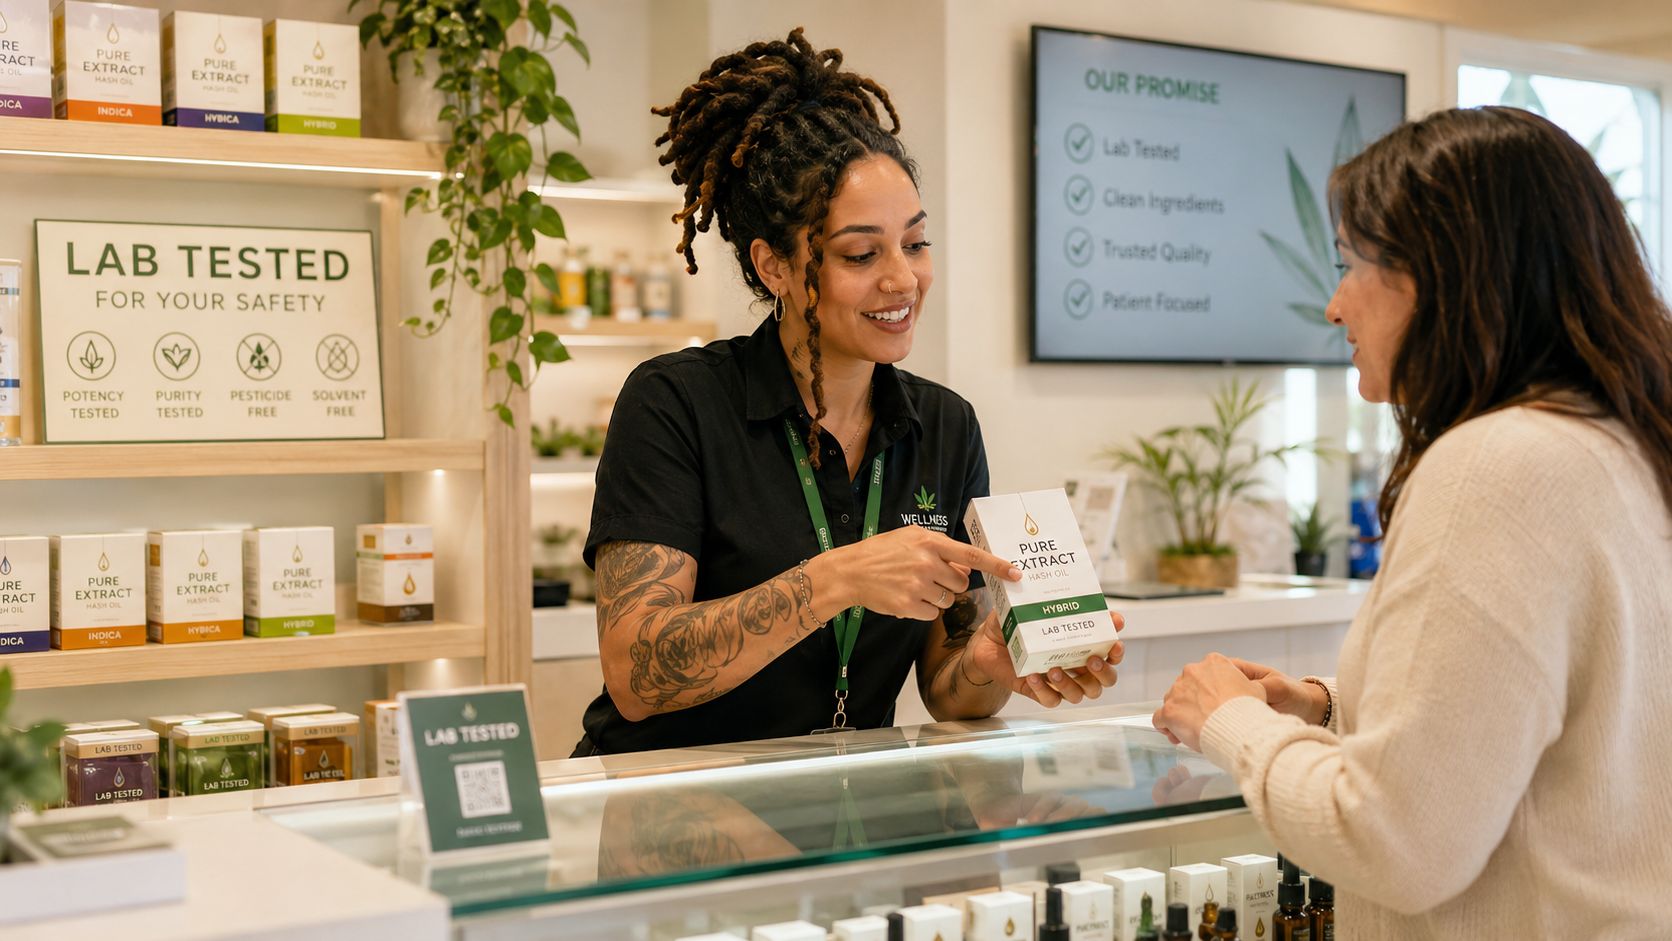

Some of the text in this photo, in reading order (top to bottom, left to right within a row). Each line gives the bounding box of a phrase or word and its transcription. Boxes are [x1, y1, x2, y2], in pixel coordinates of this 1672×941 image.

[2, 40, 20, 51] RE
[0, 54, 36, 66] RACT
[97, 49, 131, 61] PURE
[83, 61, 145, 75] EXTRACT
[204, 58, 237, 70] PURE
[304, 65, 334, 76] PURE
[95, 76, 118, 85] HASH
[192, 70, 250, 85] EXTRACT
[292, 76, 347, 90] EXTRACT
[1085, 68, 1220, 104] OUR PROMISE
[98, 107, 133, 117] INDICA
[304, 120, 337, 130] HYBRID
[1102, 138, 1180, 161] Lab Tested
[1104, 188, 1225, 215] Clean Ingredients
[1102, 240, 1212, 265] Trusted Quality
[67, 242, 349, 281] LAB TESTED
[95, 290, 326, 312] FOR YOUR SAFETY
[1103, 292, 1211, 313] Patient Focused
[63, 390, 124, 402] POTENCY
[156, 390, 202, 401] PURITY
[230, 390, 292, 401] PESTICIDE
[312, 390, 367, 401] SOLVENT
[71, 408, 119, 419] TESTED
[156, 407, 204, 418] TESTED
[248, 406, 278, 418] FREE
[326, 405, 356, 417] FREE
[1019, 540, 1058, 555] PURE
[189, 572, 218, 582] PURE
[284, 568, 312, 578] PURE
[1029, 569, 1069, 581] HASH OIL
[0, 580, 22, 591] URE
[88, 576, 119, 587] PURE
[273, 579, 323, 591] EXTRACT
[76, 588, 132, 600] EXTRACT
[177, 584, 230, 596] EXTRACT
[2, 592, 36, 603] RACT
[1043, 601, 1080, 614] HYBRID
[284, 620, 315, 629] HYBRID
[1042, 620, 1095, 636] LAB TESTED
[0, 637, 24, 646] DICA
[88, 631, 122, 640] INDICA
[222, 734, 250, 742] TESTED
[424, 722, 520, 746] LAB TESTED
[95, 743, 142, 754] LAB TESTED
[204, 779, 250, 790] LAB TESTED
[96, 791, 111, 800] LAB
[113, 788, 143, 799] TESTED
